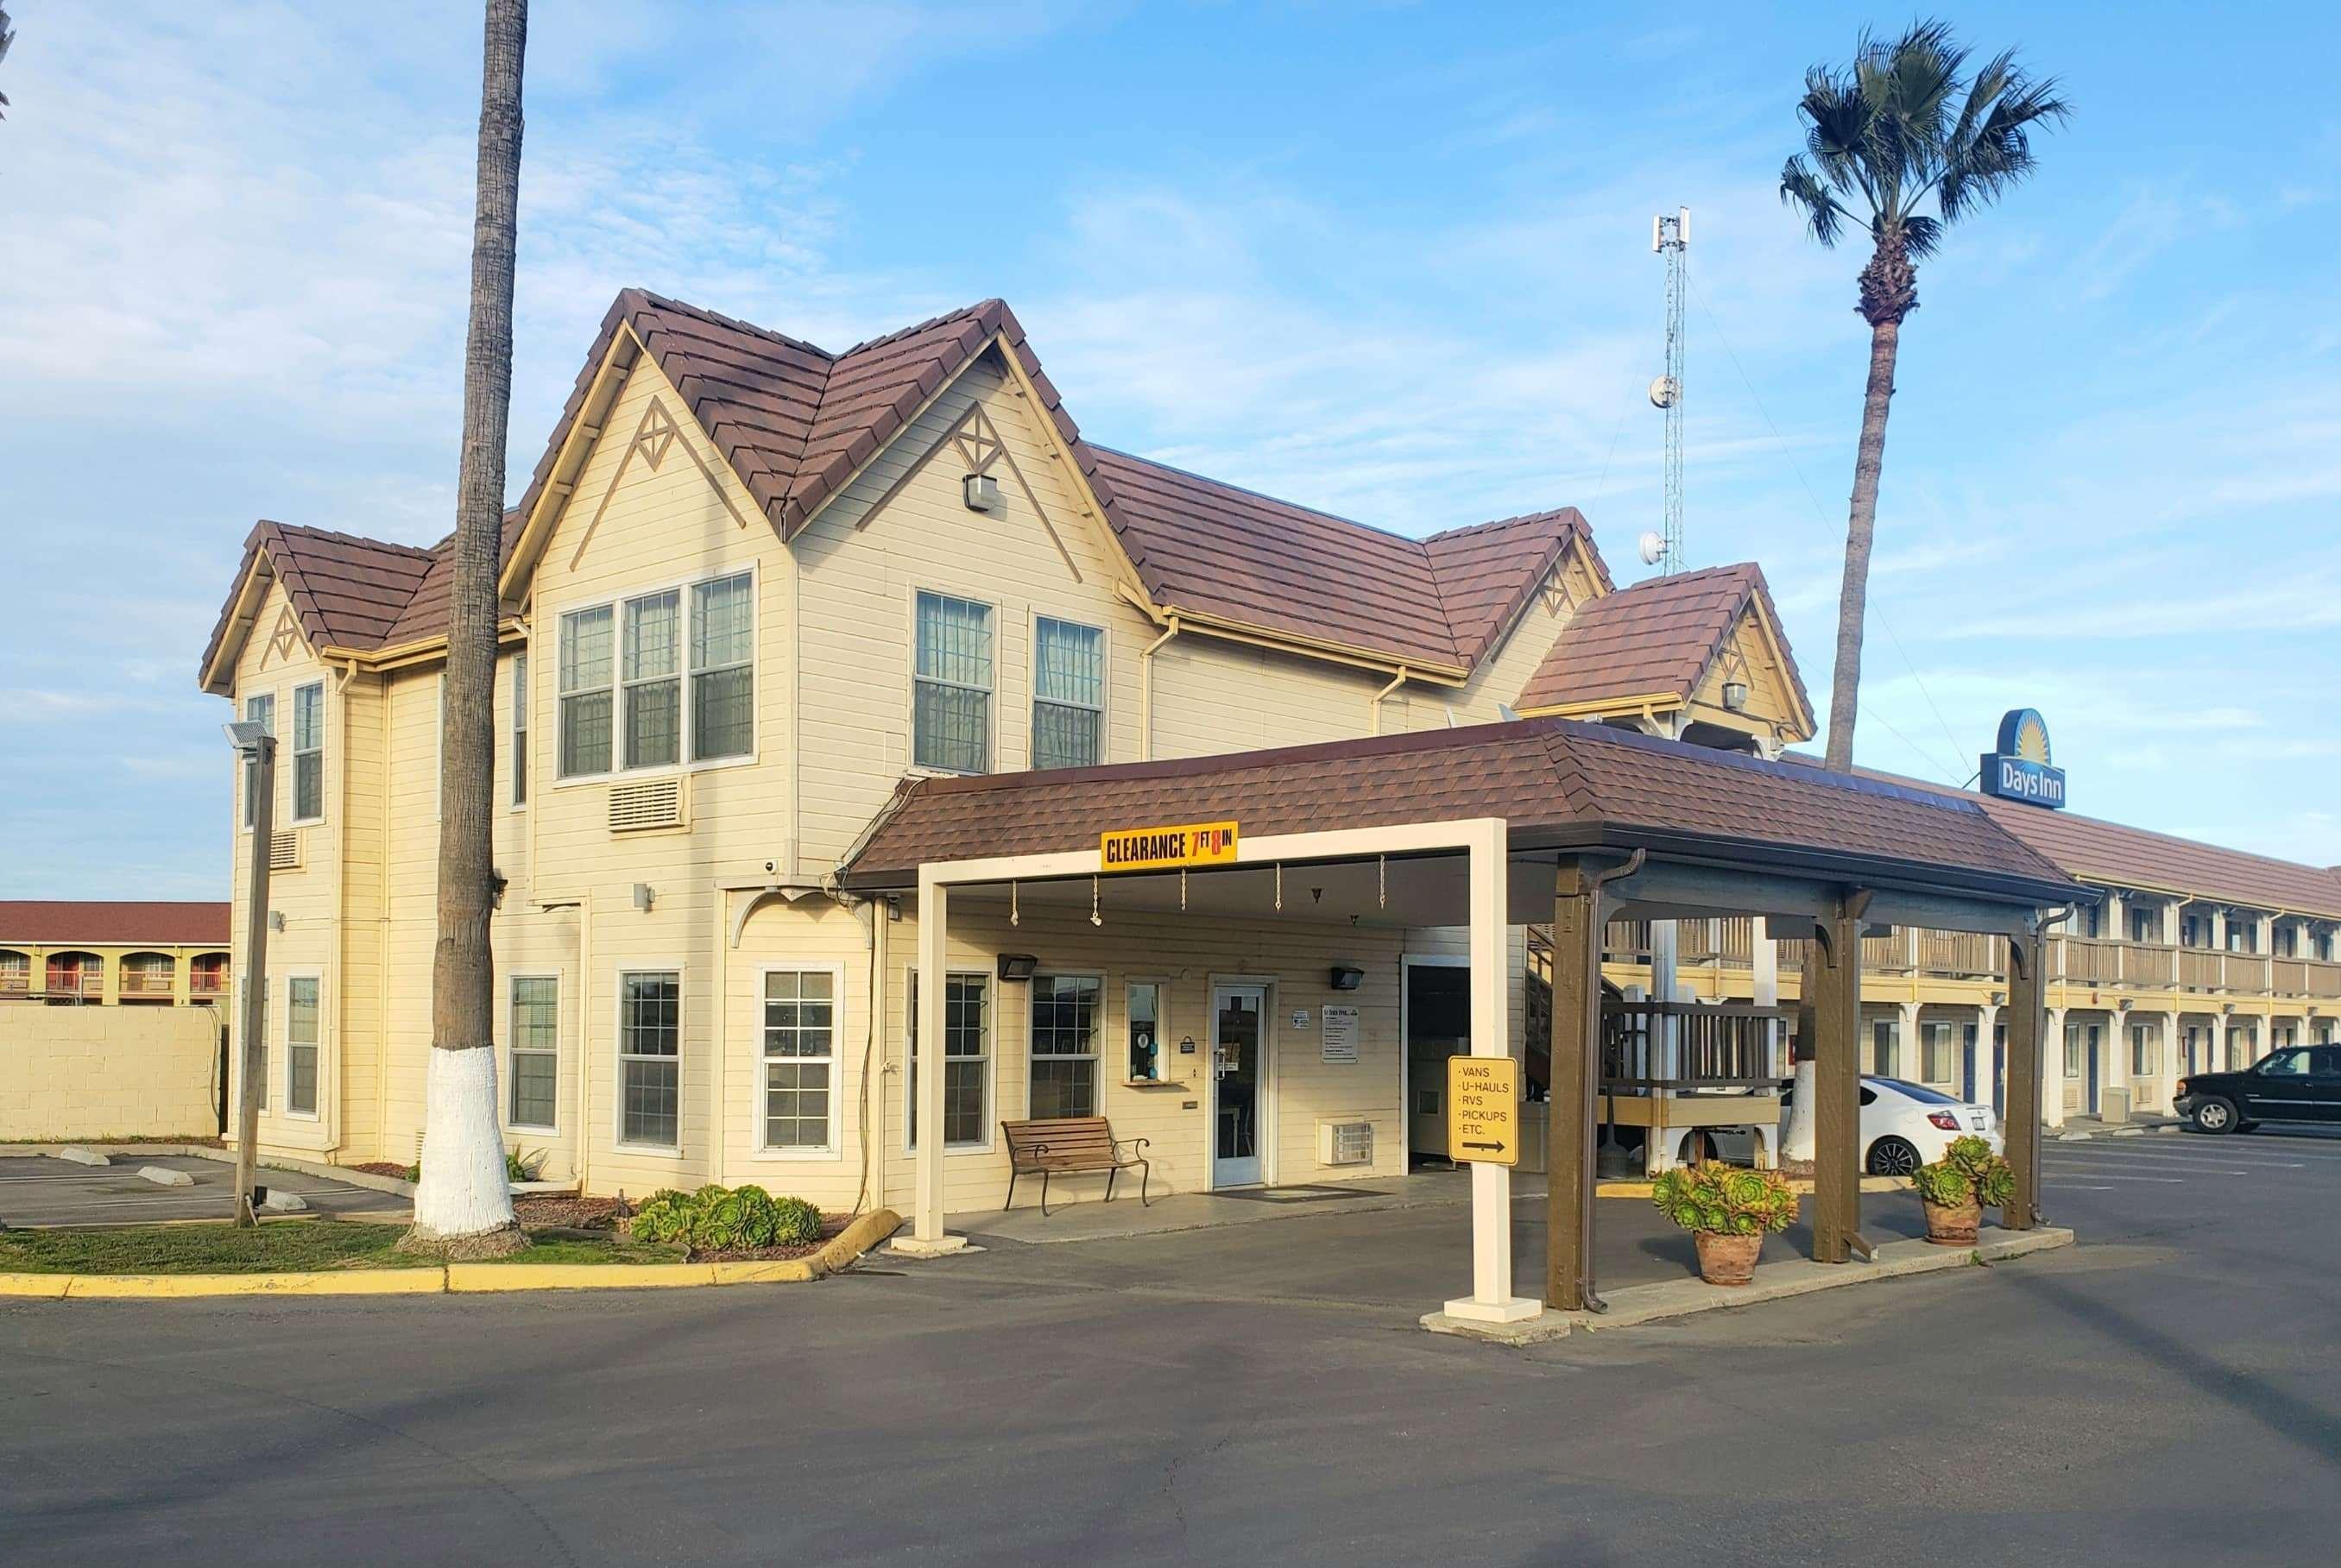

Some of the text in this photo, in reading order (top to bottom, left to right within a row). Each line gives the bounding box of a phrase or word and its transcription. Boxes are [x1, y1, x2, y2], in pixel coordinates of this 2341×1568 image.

[2003, 761, 2061, 801] Days Inn
[1107, 833, 1186, 864] CLEARANCE
[1462, 1067, 1490, 1078] VANS
[1462, 1081, 1510, 1093] U-HAULS
[1462, 1095, 1484, 1106] RVS
[1462, 1110, 1507, 1122] PICKUPS
[1462, 1124, 1486, 1135] ETC.
